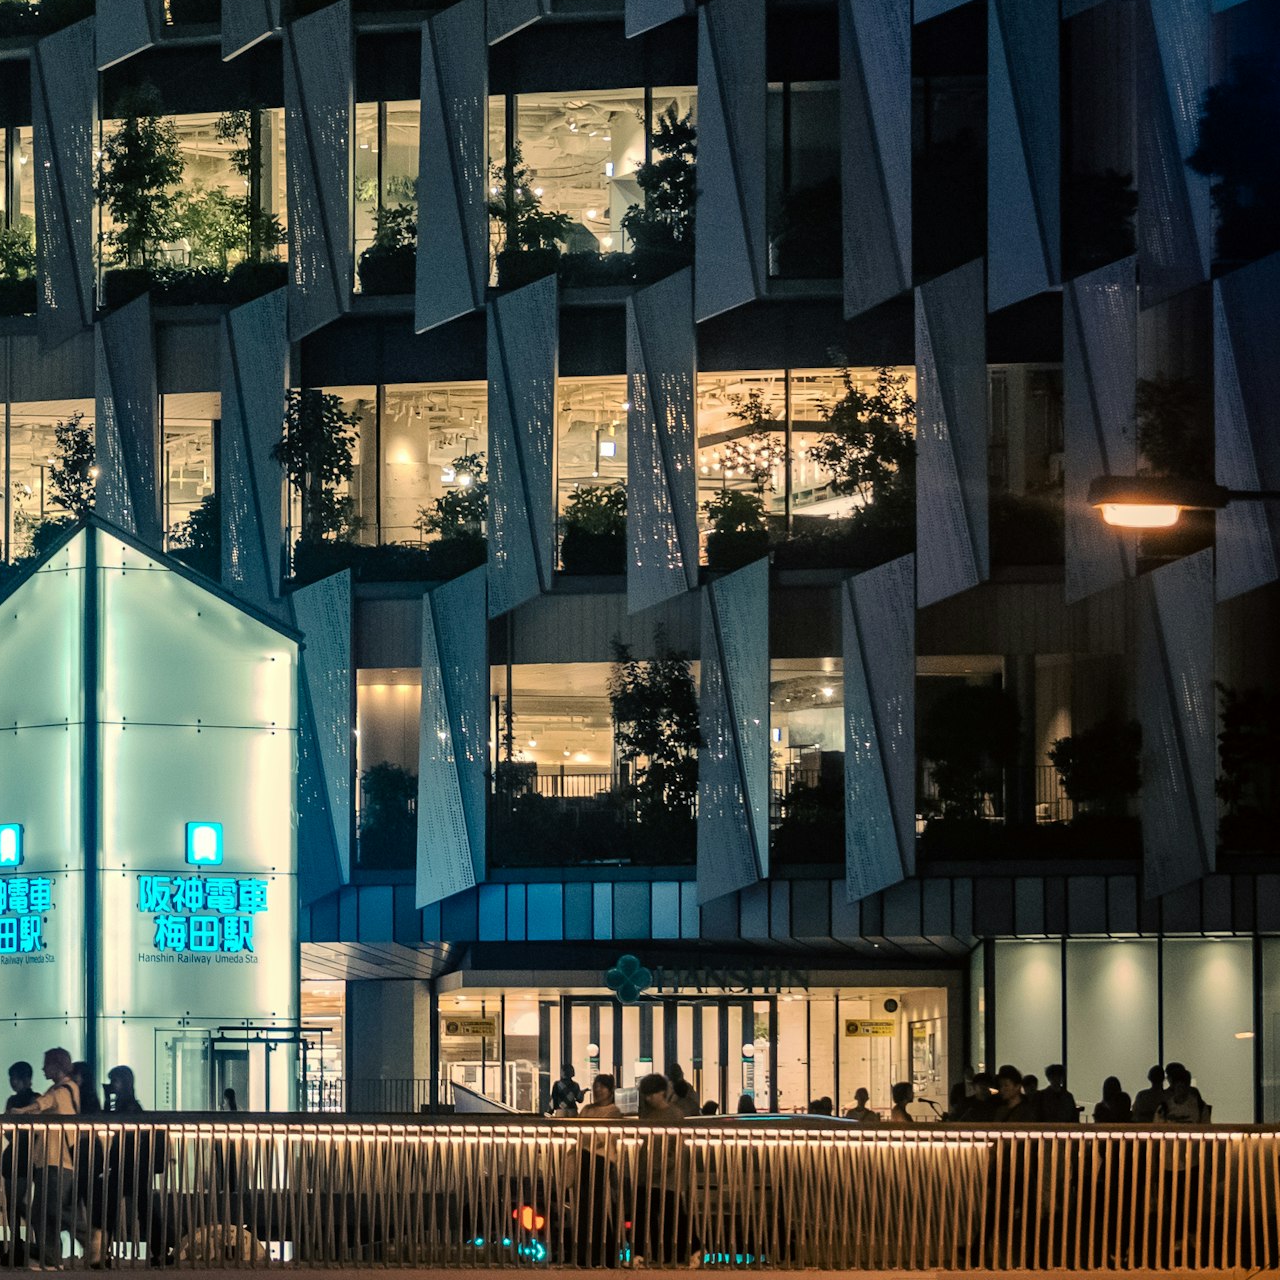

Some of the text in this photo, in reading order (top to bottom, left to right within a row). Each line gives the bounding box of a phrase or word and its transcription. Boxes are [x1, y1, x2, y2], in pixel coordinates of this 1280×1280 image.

[139, 876, 268, 914] 阪神電車
[155, 915, 254, 952] 梅田駅
[1, 955, 24, 966] Railway
[26, 953, 45, 964] Umeda
[138, 953, 174, 963] Hanshin
[177, 954, 211, 965] Railway
[215, 954, 244, 964] Umeda
[656, 966, 810, 993] HANSHIN
